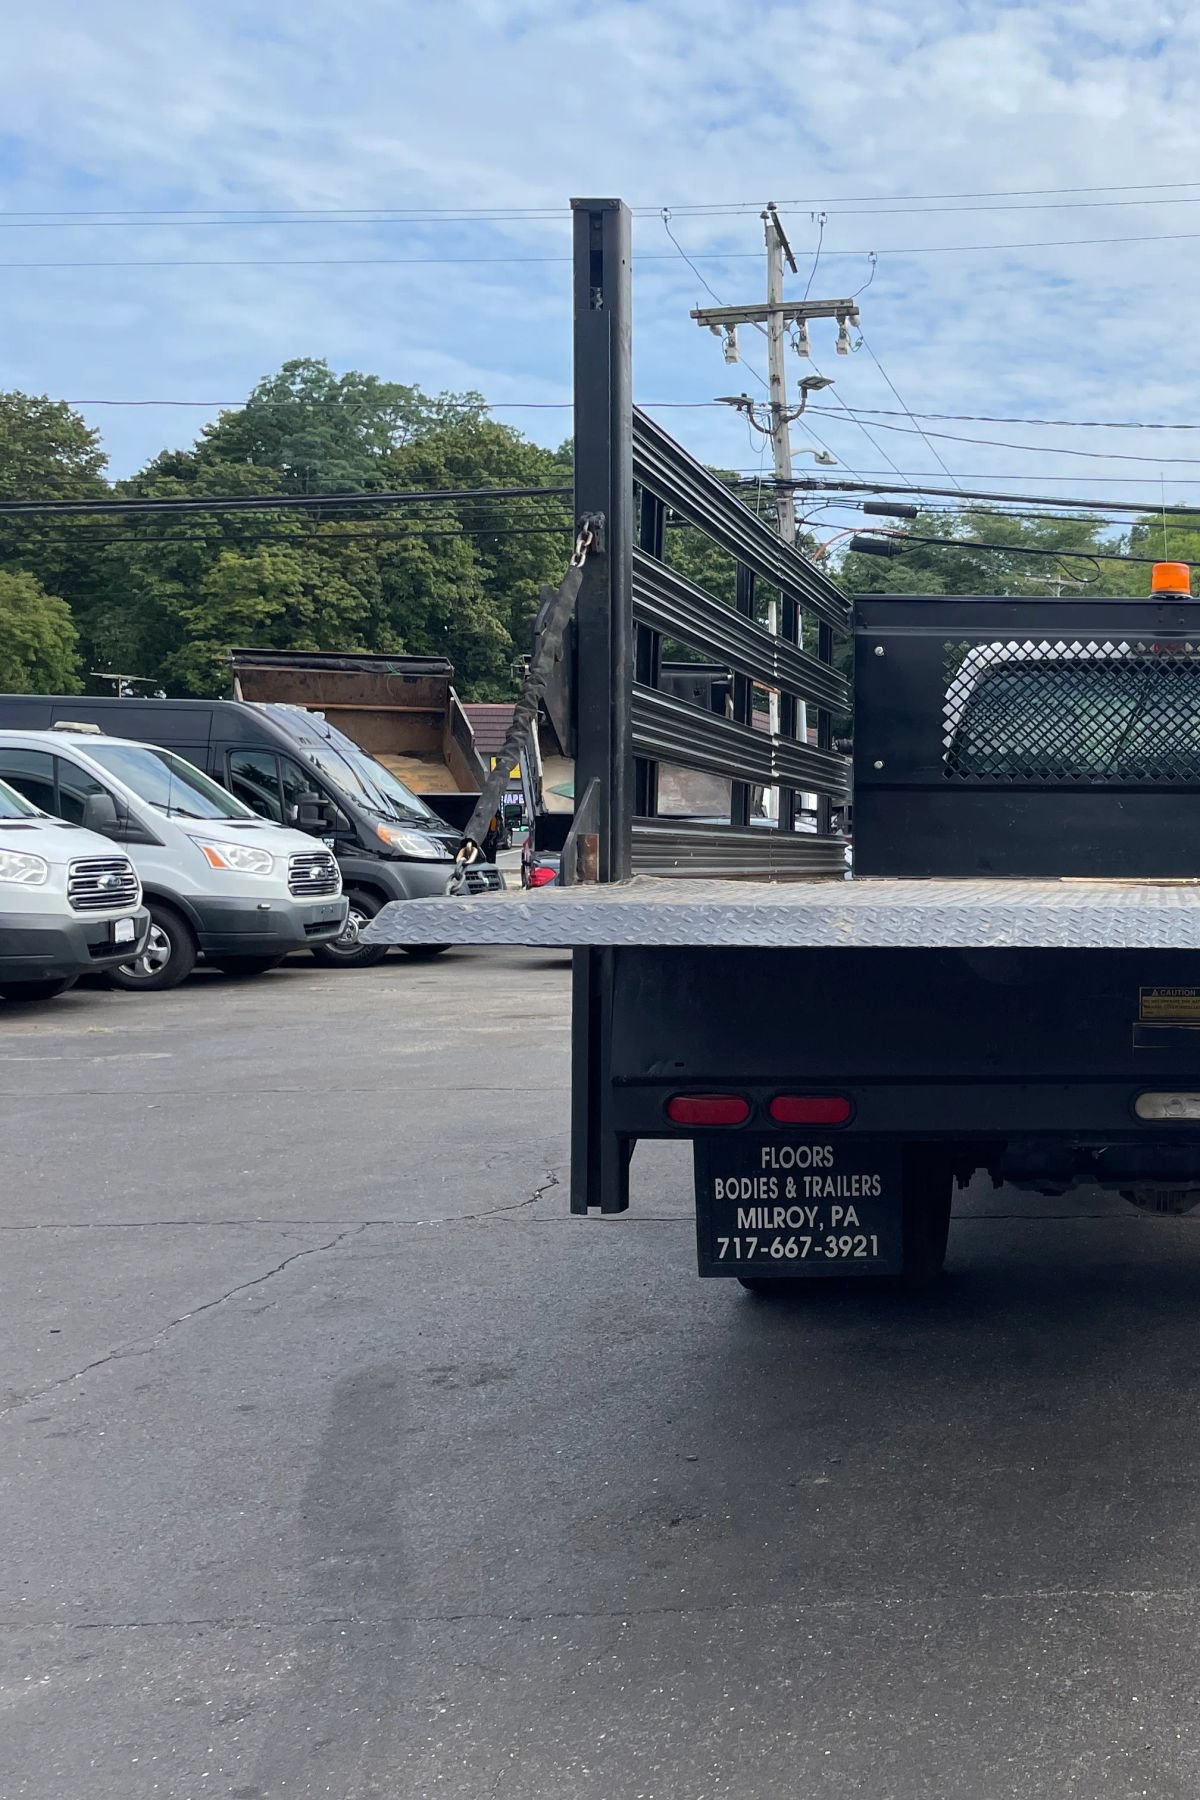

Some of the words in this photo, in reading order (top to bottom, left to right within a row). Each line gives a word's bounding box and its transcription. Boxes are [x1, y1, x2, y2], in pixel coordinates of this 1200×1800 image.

[1160, 989, 1196, 997] CAUTION
[761, 1146, 834, 1169] FLOORS
[714, 1176, 779, 1200] BODIES
[785, 1176, 797, 1198] &
[804, 1174, 881, 1198] TRAILERS
[736, 1205, 824, 1232] MILROY,
[831, 1205, 860, 1228] PA
[717, 1235, 879, 1260] 717-667-3921
